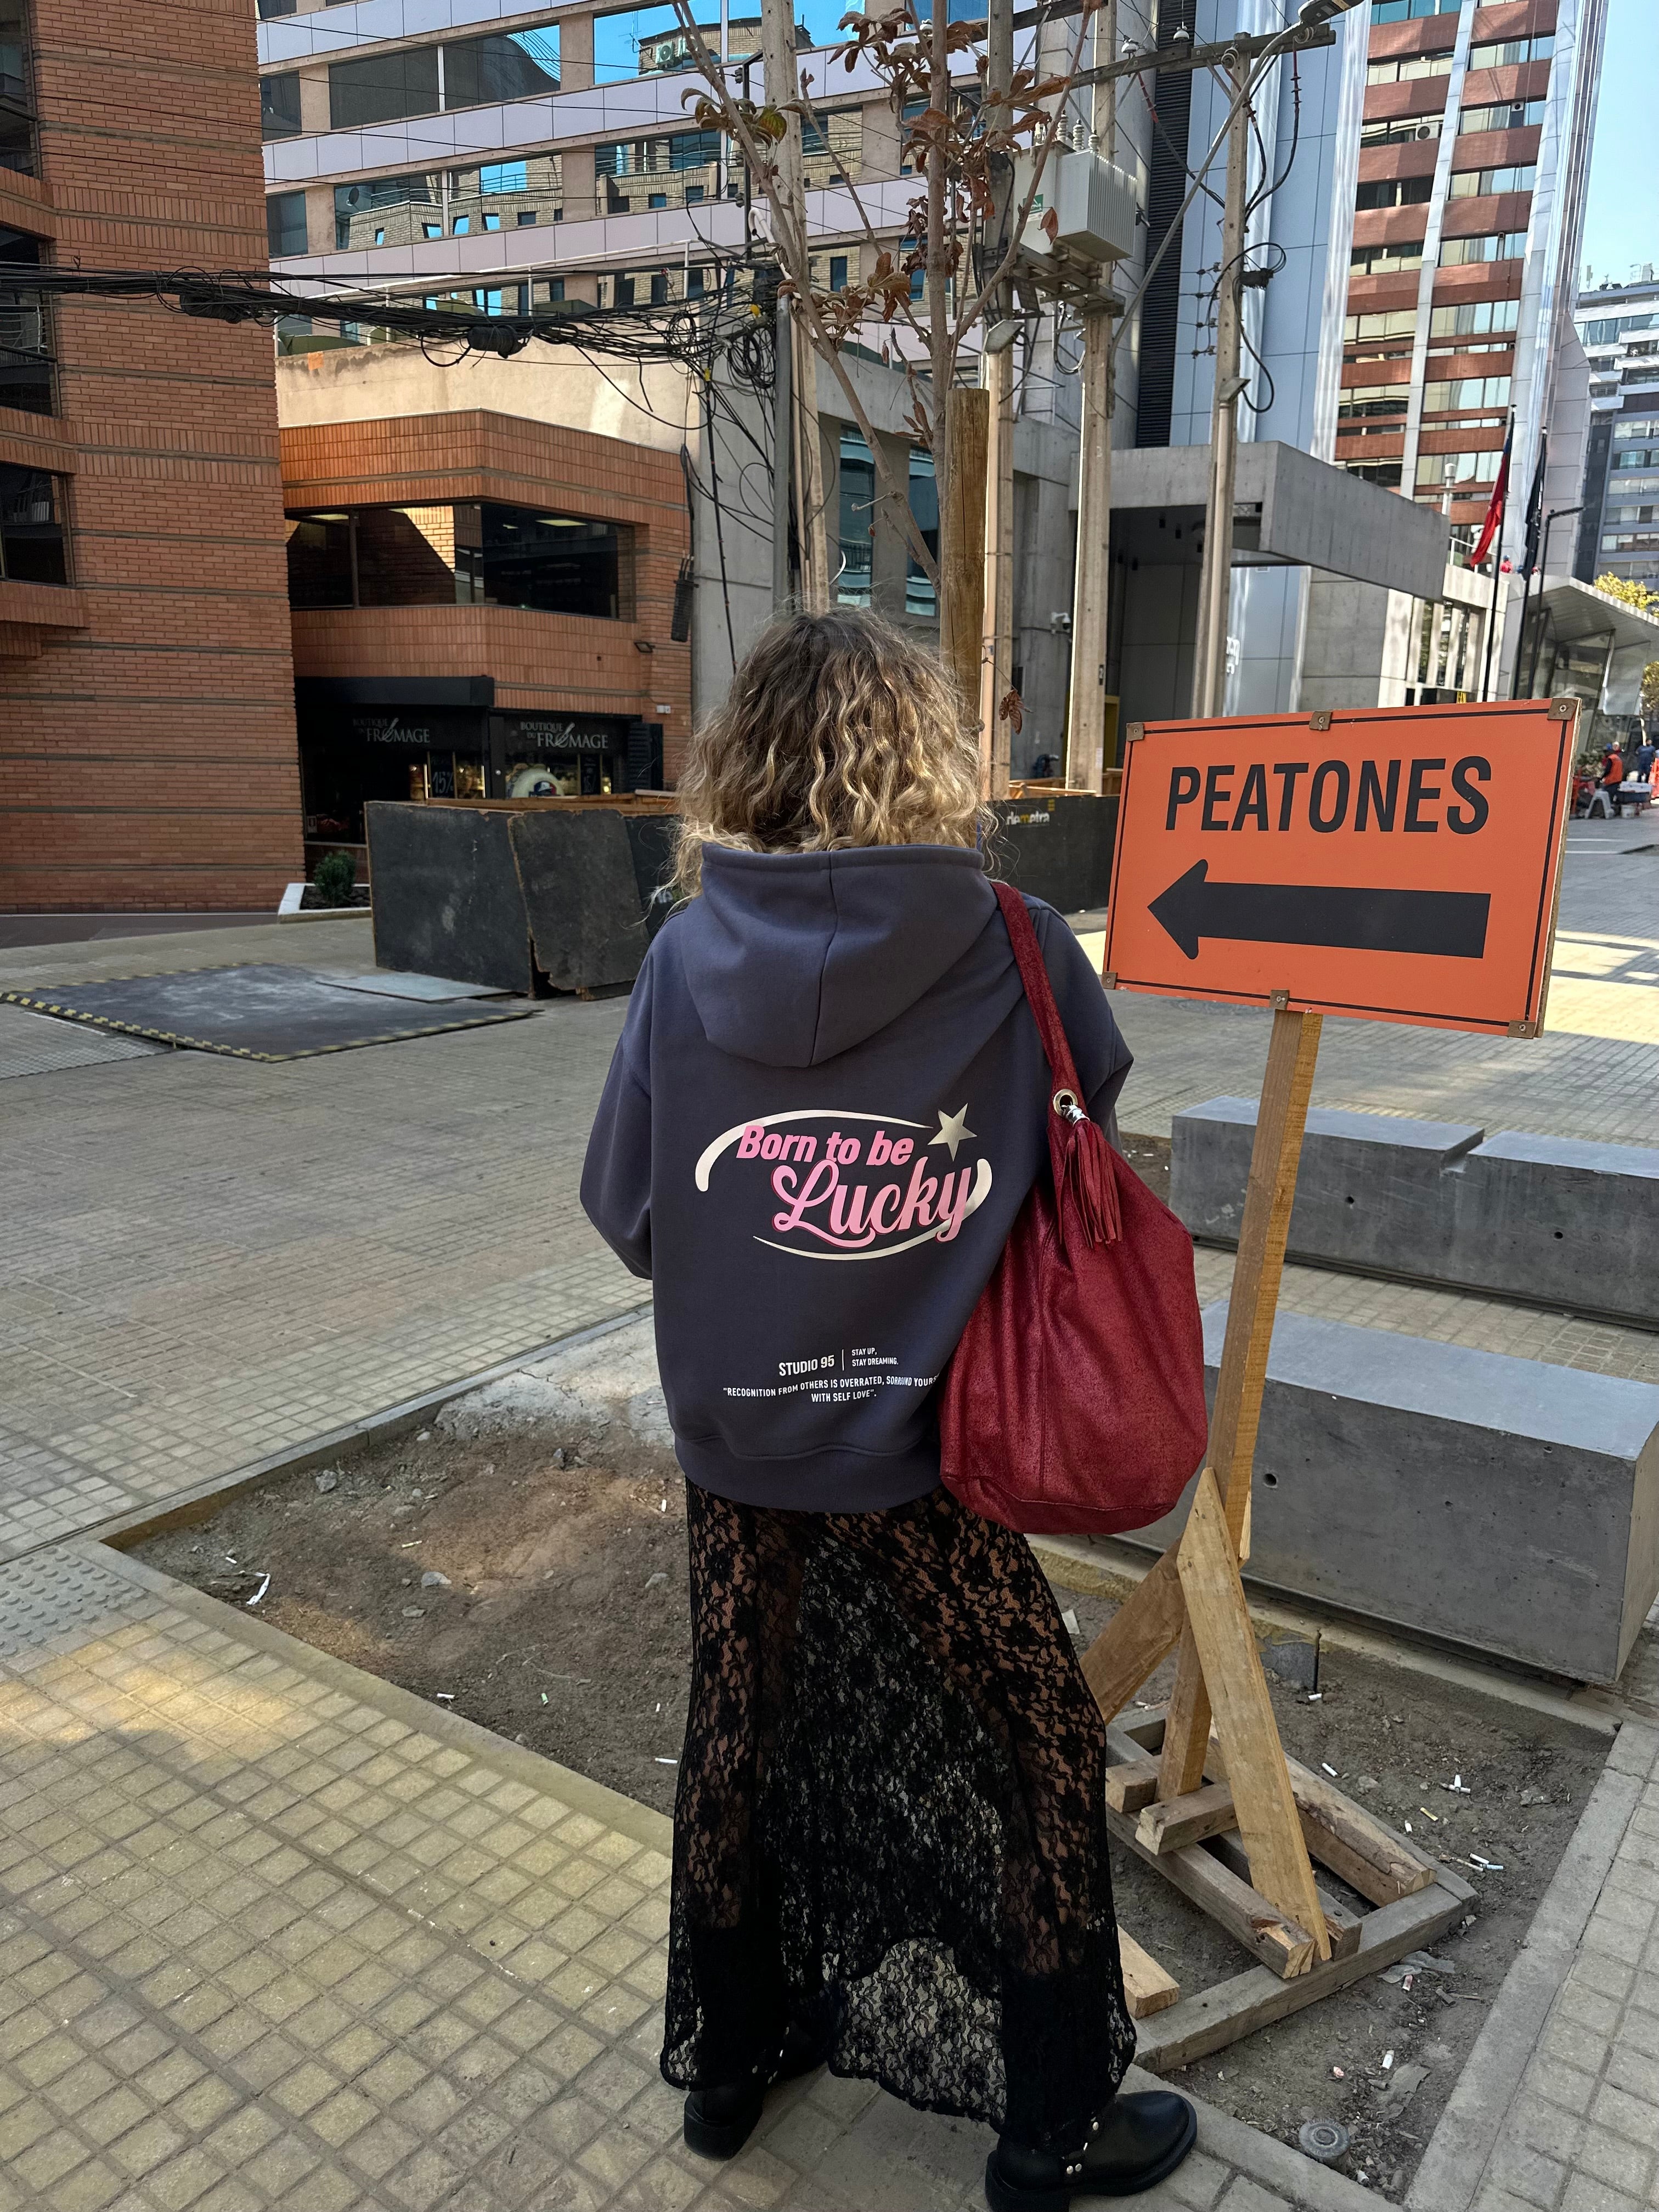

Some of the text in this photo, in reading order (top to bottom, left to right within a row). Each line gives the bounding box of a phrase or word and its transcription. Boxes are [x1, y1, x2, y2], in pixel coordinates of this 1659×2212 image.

[366, 725, 431, 743] FROMAGE
[520, 721, 563, 733] BOUTIQUE
[537, 730, 608, 749] FROMAGE
[1165, 755, 1492, 835] PEATONES
[736, 1125, 914, 1166] Born to be
[770, 1156, 972, 1248] Lucky
[778, 1355, 834, 1376] STUDIO 95
[868, 1357, 899, 1365] DREAMING.
[723, 1387, 776, 1397] "RECOGNITION
[778, 1384, 798, 1395] FROM
[800, 1379, 828, 1390] OTHERS
[831, 1379, 838, 1388] IS
[840, 1376, 884, 1387] OVERRATED,
[811, 1393, 831, 1402] WITH
[833, 1392, 851, 1402] SELF
